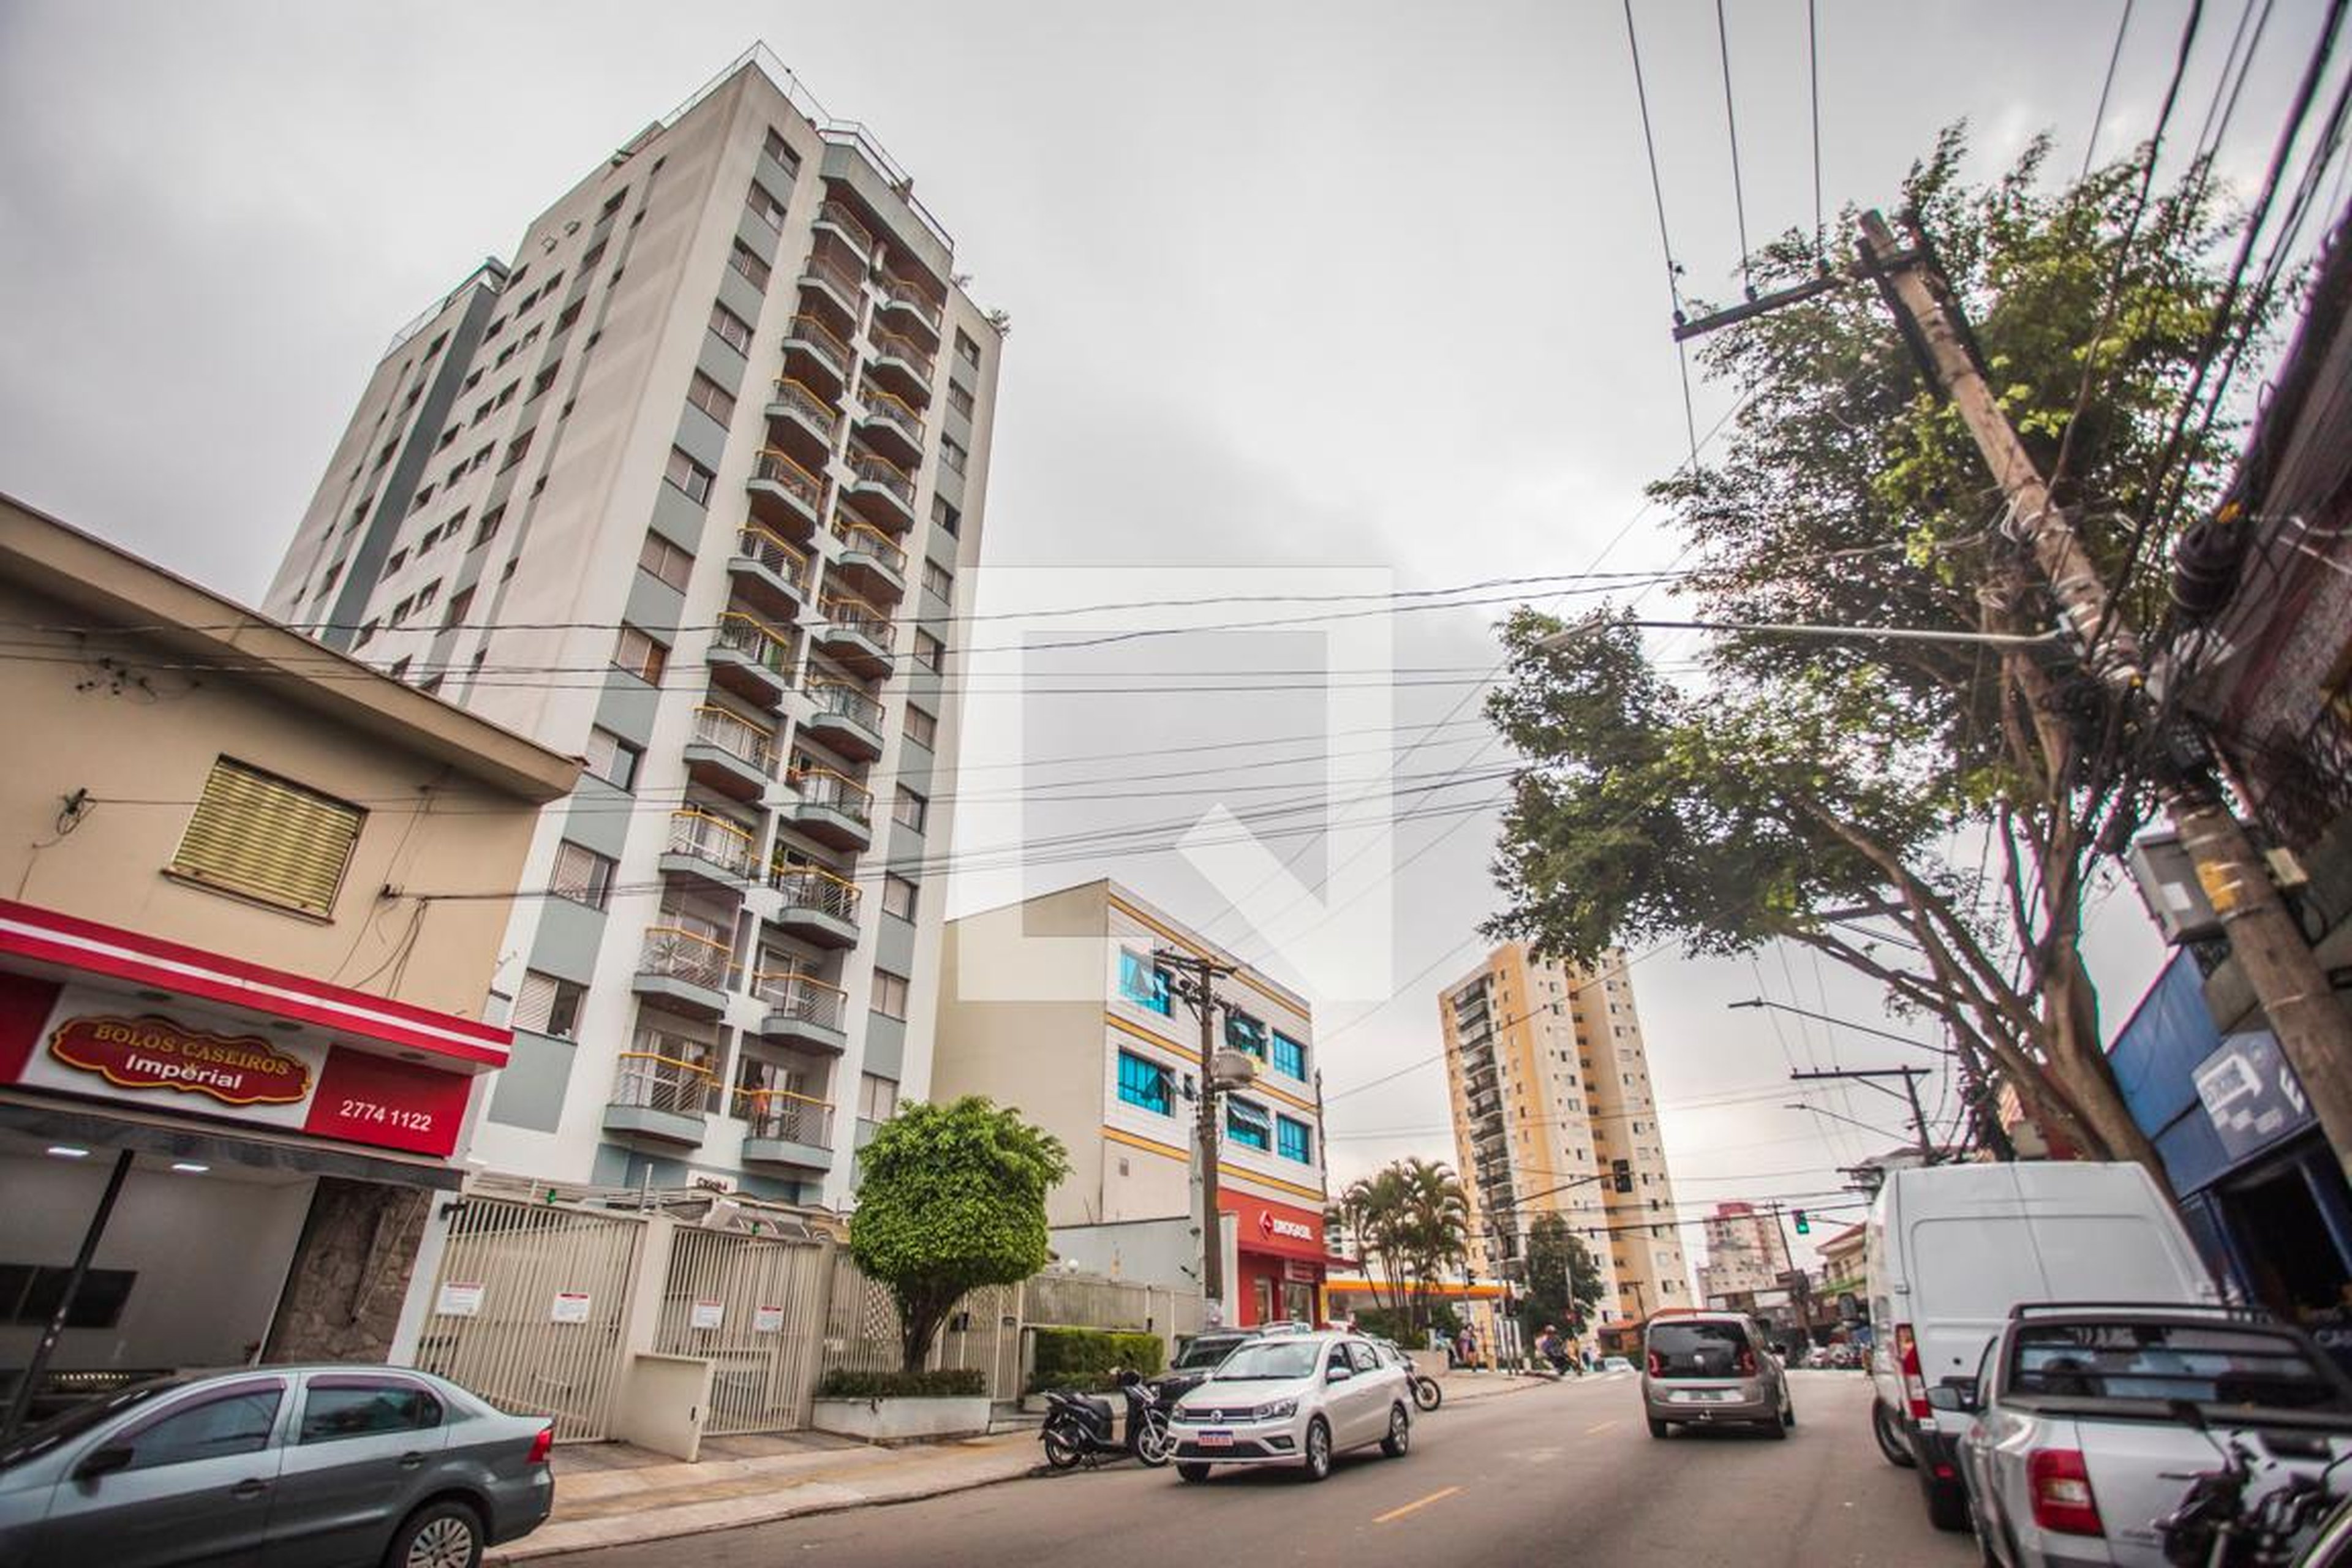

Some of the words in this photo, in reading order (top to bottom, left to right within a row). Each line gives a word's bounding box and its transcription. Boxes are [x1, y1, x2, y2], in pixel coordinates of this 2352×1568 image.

[94, 1023, 176, 1053] BOLOS
[182, 1042, 291, 1076] CASEIROS
[339, 1099, 385, 1123] 2774
[391, 1110, 432, 1132] 1122
